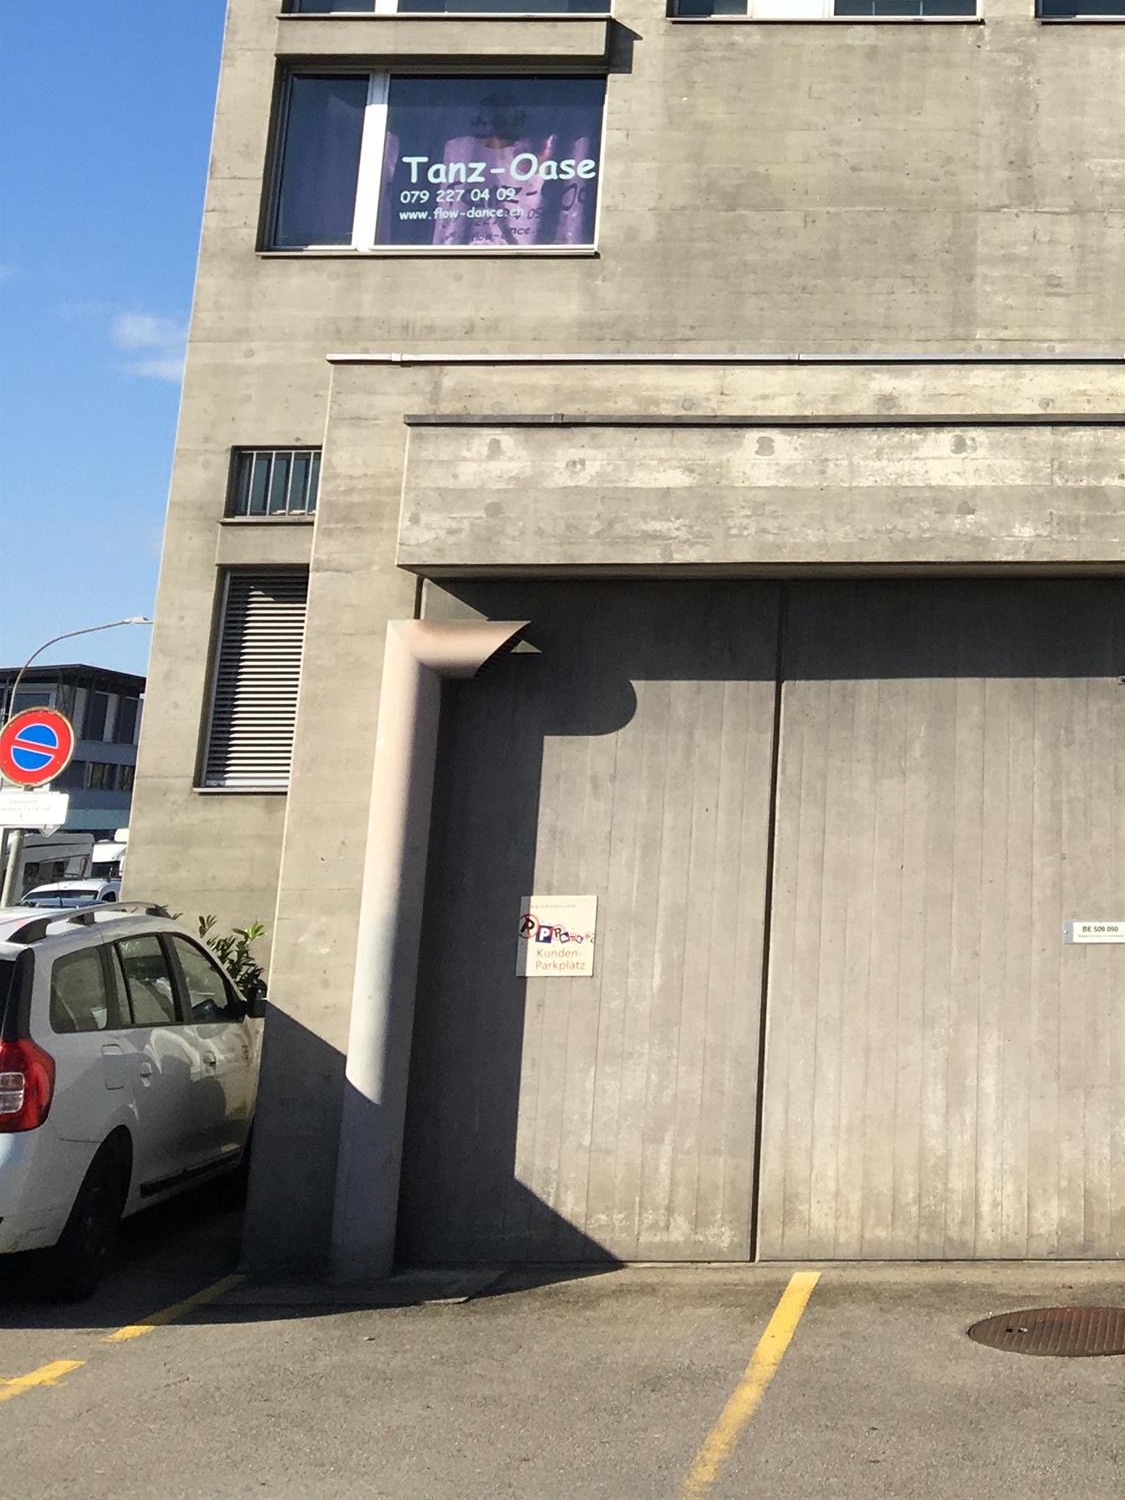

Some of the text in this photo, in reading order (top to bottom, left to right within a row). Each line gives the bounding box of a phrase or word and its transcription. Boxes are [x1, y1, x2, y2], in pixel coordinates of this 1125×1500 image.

[401, 152, 596, 185] Tanz-Oase
[400, 190, 429, 204] 079
[436, 189, 464, 203] 227
[470, 188, 490, 202] 04
[496, 187, 516, 201] 09
[399, 207, 524, 221] www.flow-dance.ch
[536, 948, 582, 959] Kunden-
[535, 960, 586, 972] Parkplatz
